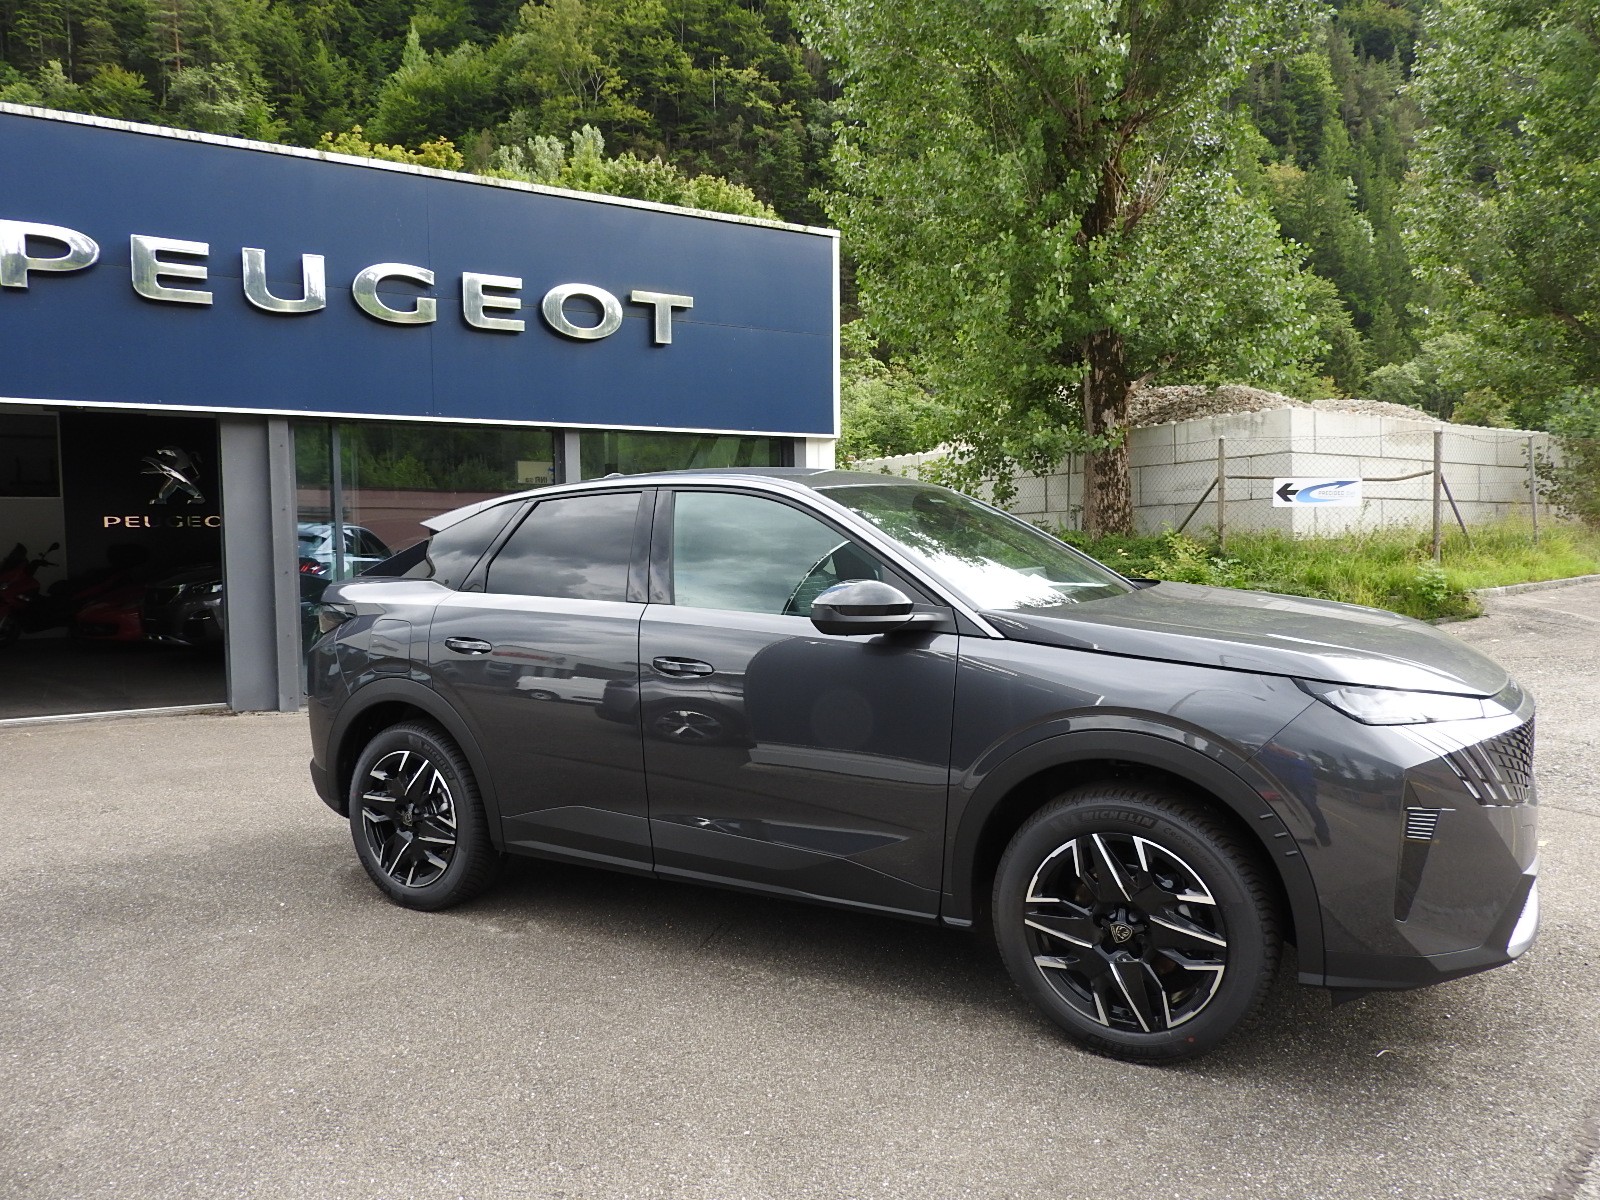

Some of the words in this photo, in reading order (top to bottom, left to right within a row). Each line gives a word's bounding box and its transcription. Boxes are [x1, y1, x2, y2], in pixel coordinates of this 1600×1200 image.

[0, 218, 694, 346] PEUGEOT
[103, 515, 221, 528] PEUGEO
[1081, 810, 1153, 827] MICHELIN
